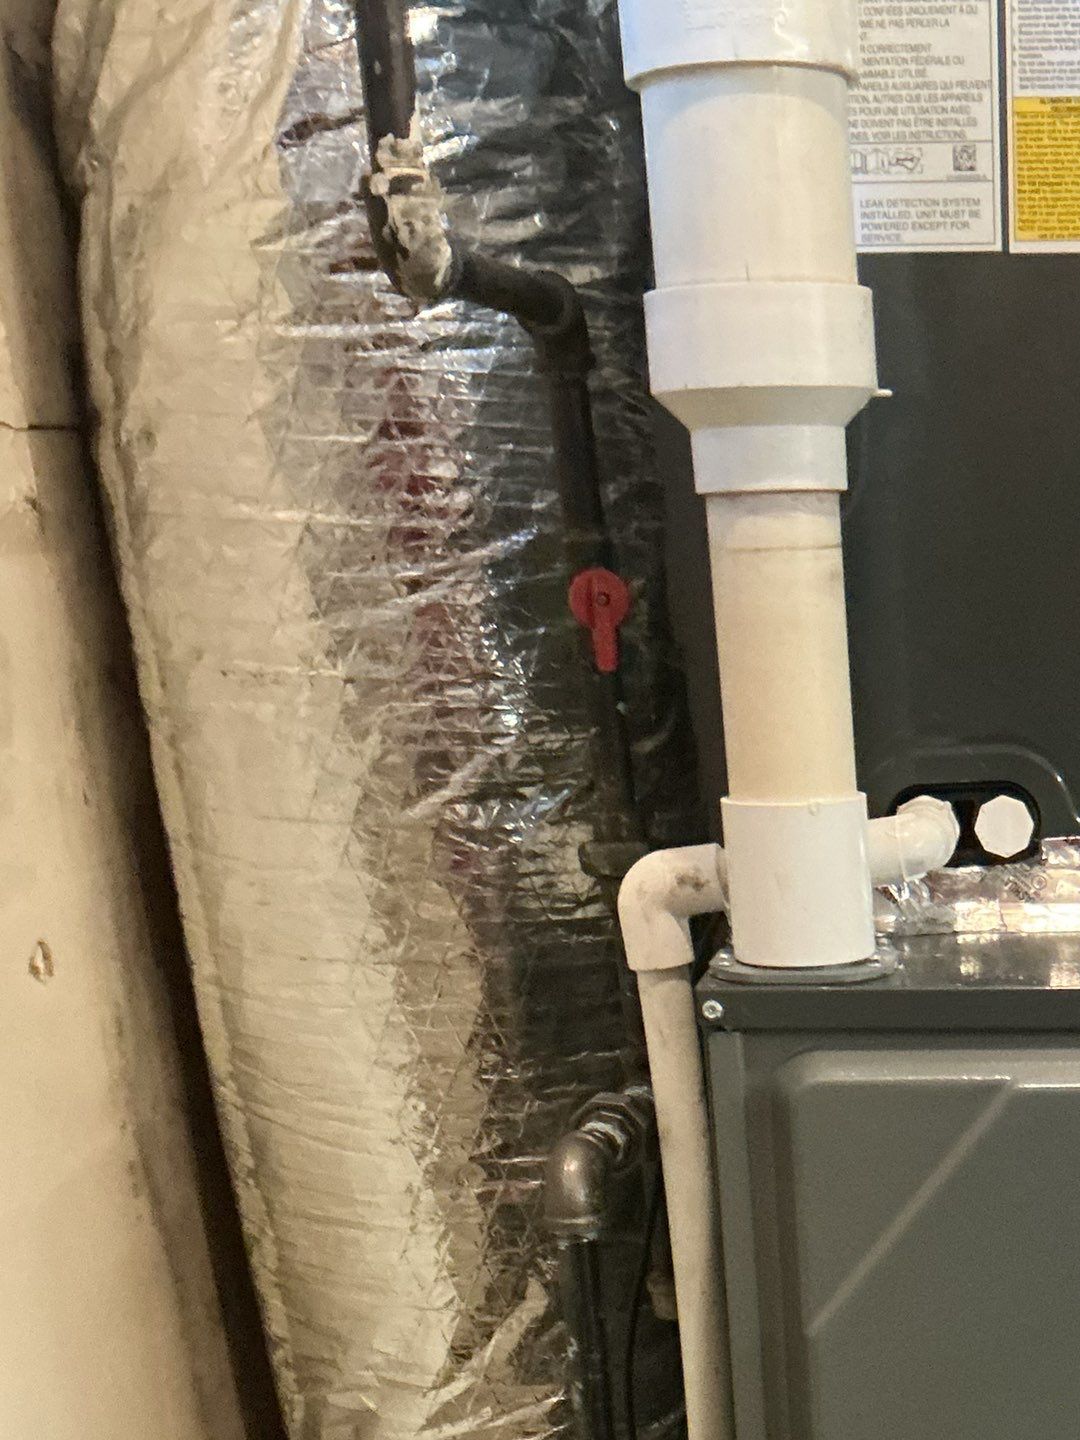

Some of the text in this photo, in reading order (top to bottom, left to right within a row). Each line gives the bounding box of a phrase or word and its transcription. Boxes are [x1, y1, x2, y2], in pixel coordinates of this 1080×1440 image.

[859, 197, 981, 208] LEAK DETECTION SYSTEM
[915, 210, 937, 219] UNIT
[939, 209, 966, 219] MUST
[968, 209, 981, 218] BE
[860, 221, 971, 231] POWERED EXCEPT FOR
